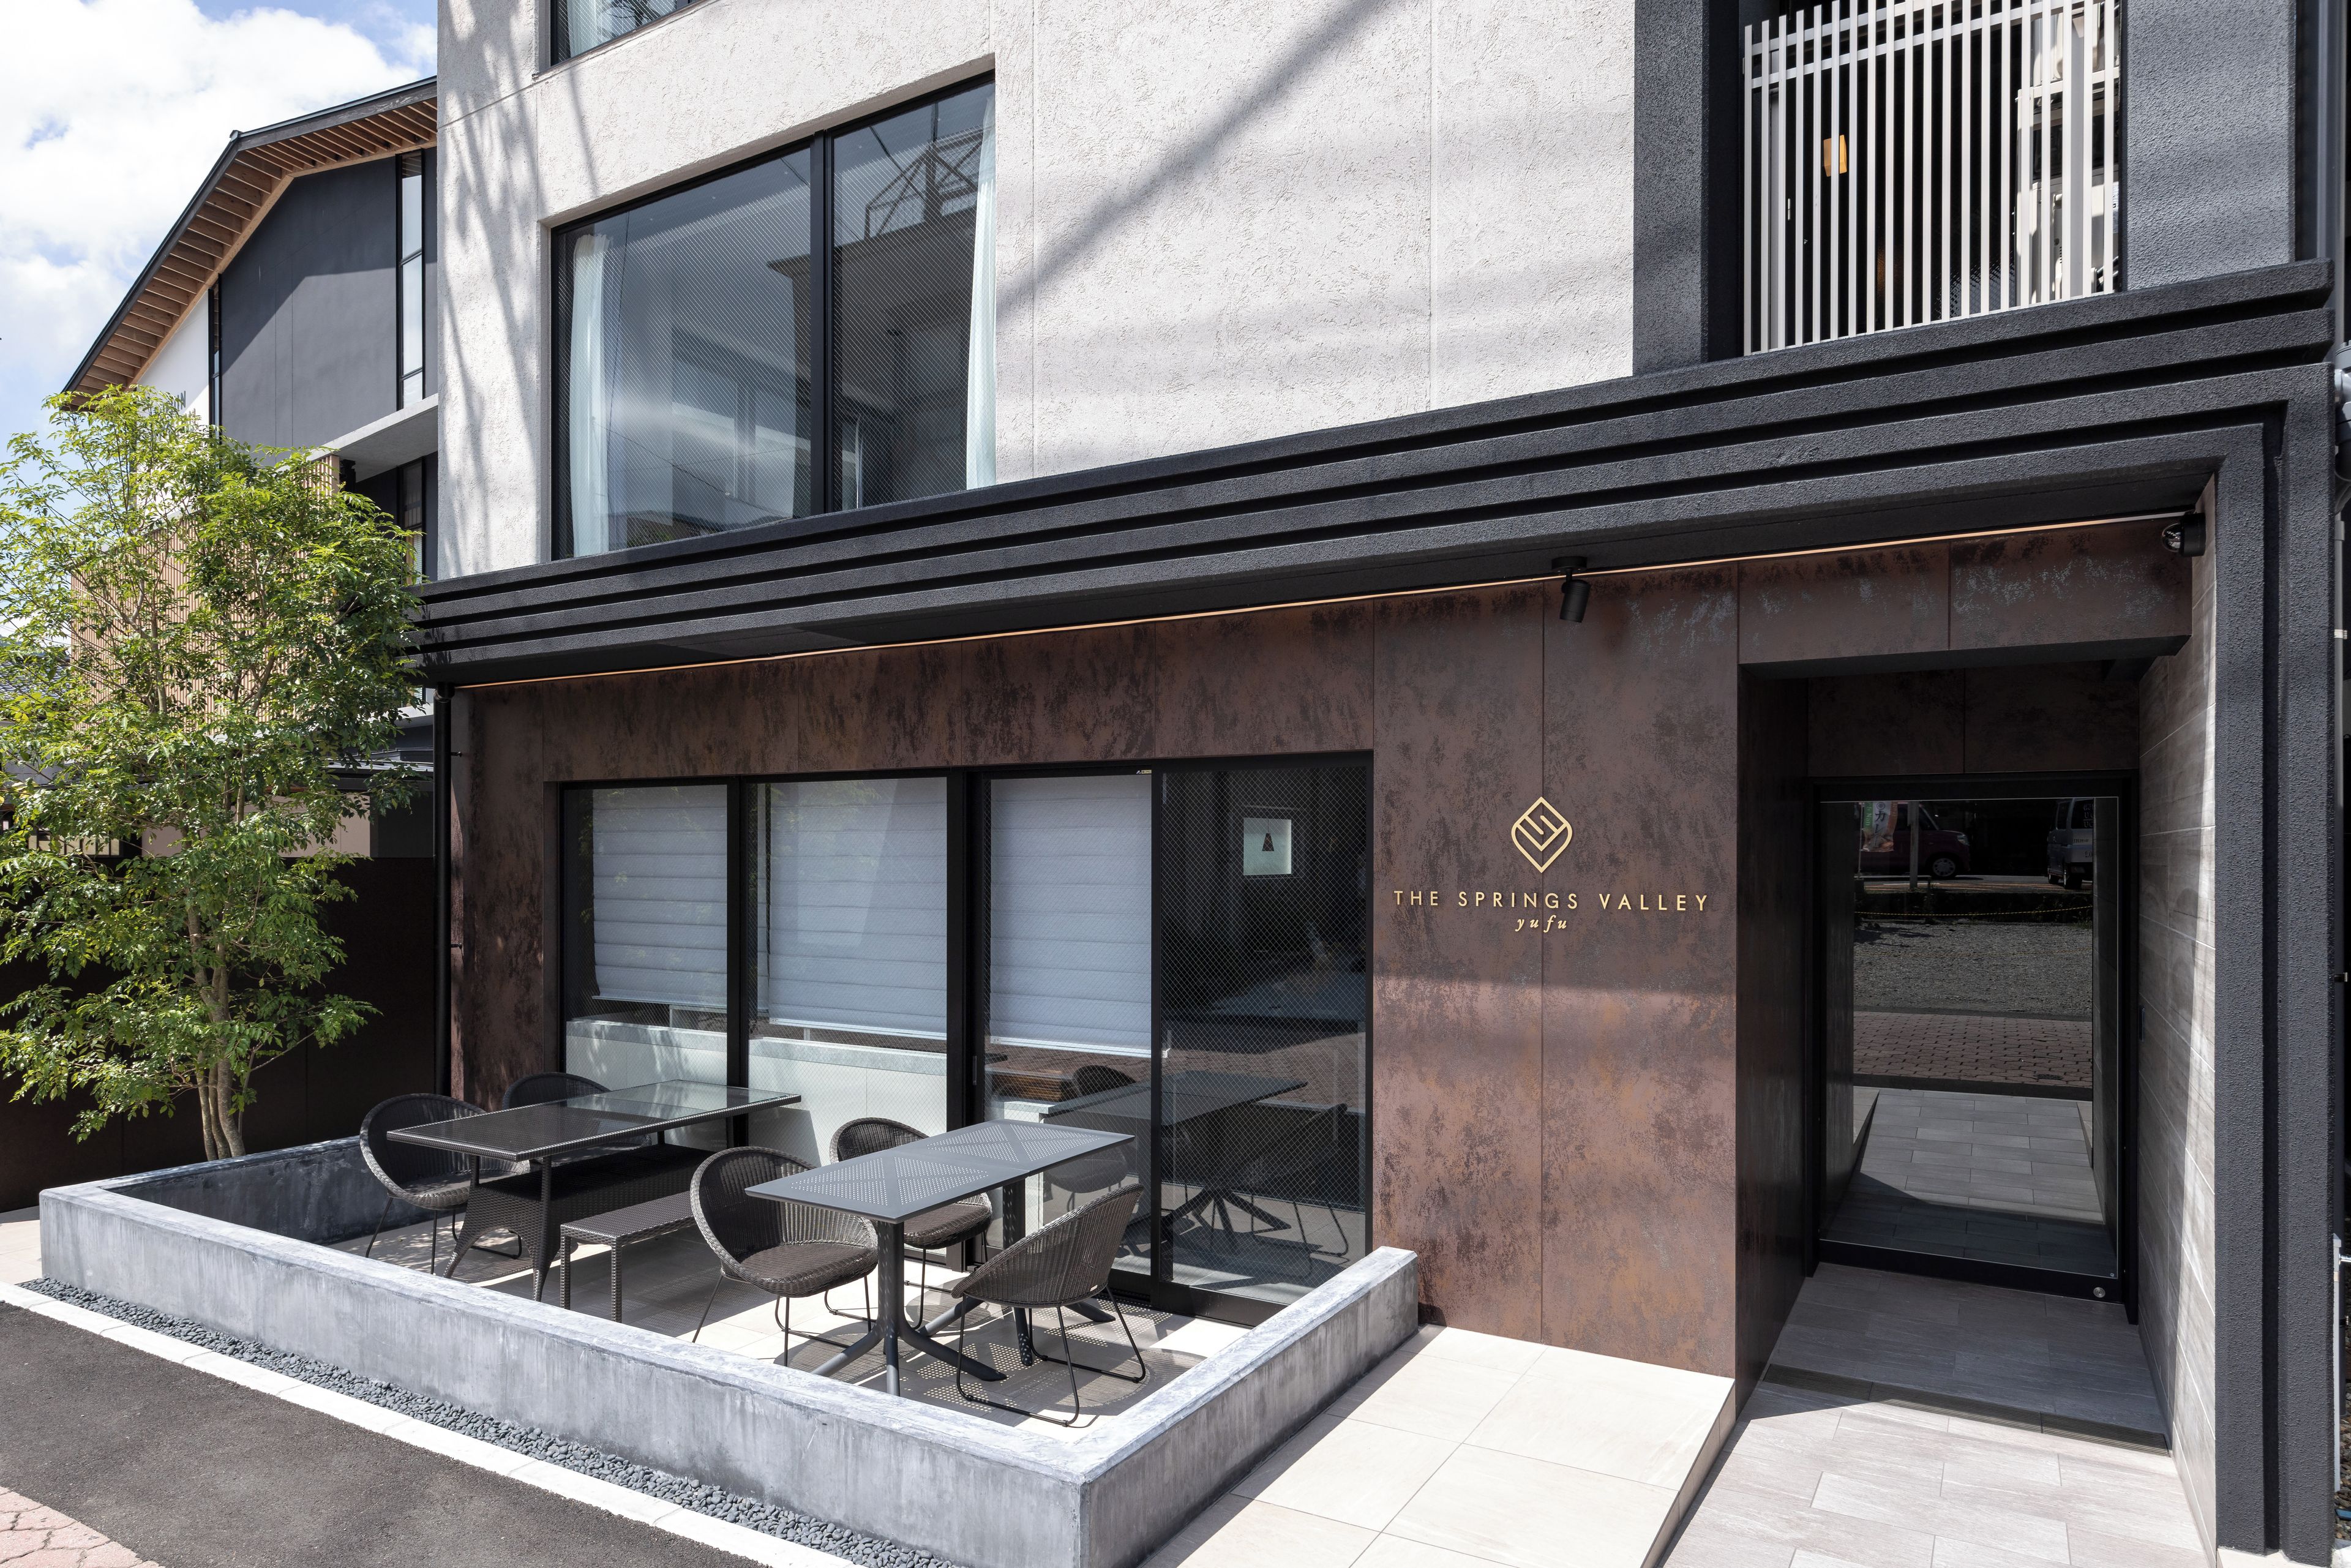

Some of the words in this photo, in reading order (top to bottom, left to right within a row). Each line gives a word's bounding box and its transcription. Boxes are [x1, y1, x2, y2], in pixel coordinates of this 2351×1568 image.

[1393, 890, 1438, 906] THE
[1458, 891, 1578, 909] SPRINGS
[1599, 893, 1707, 911] VALLEY
[1515, 915, 1567, 933] yufu
